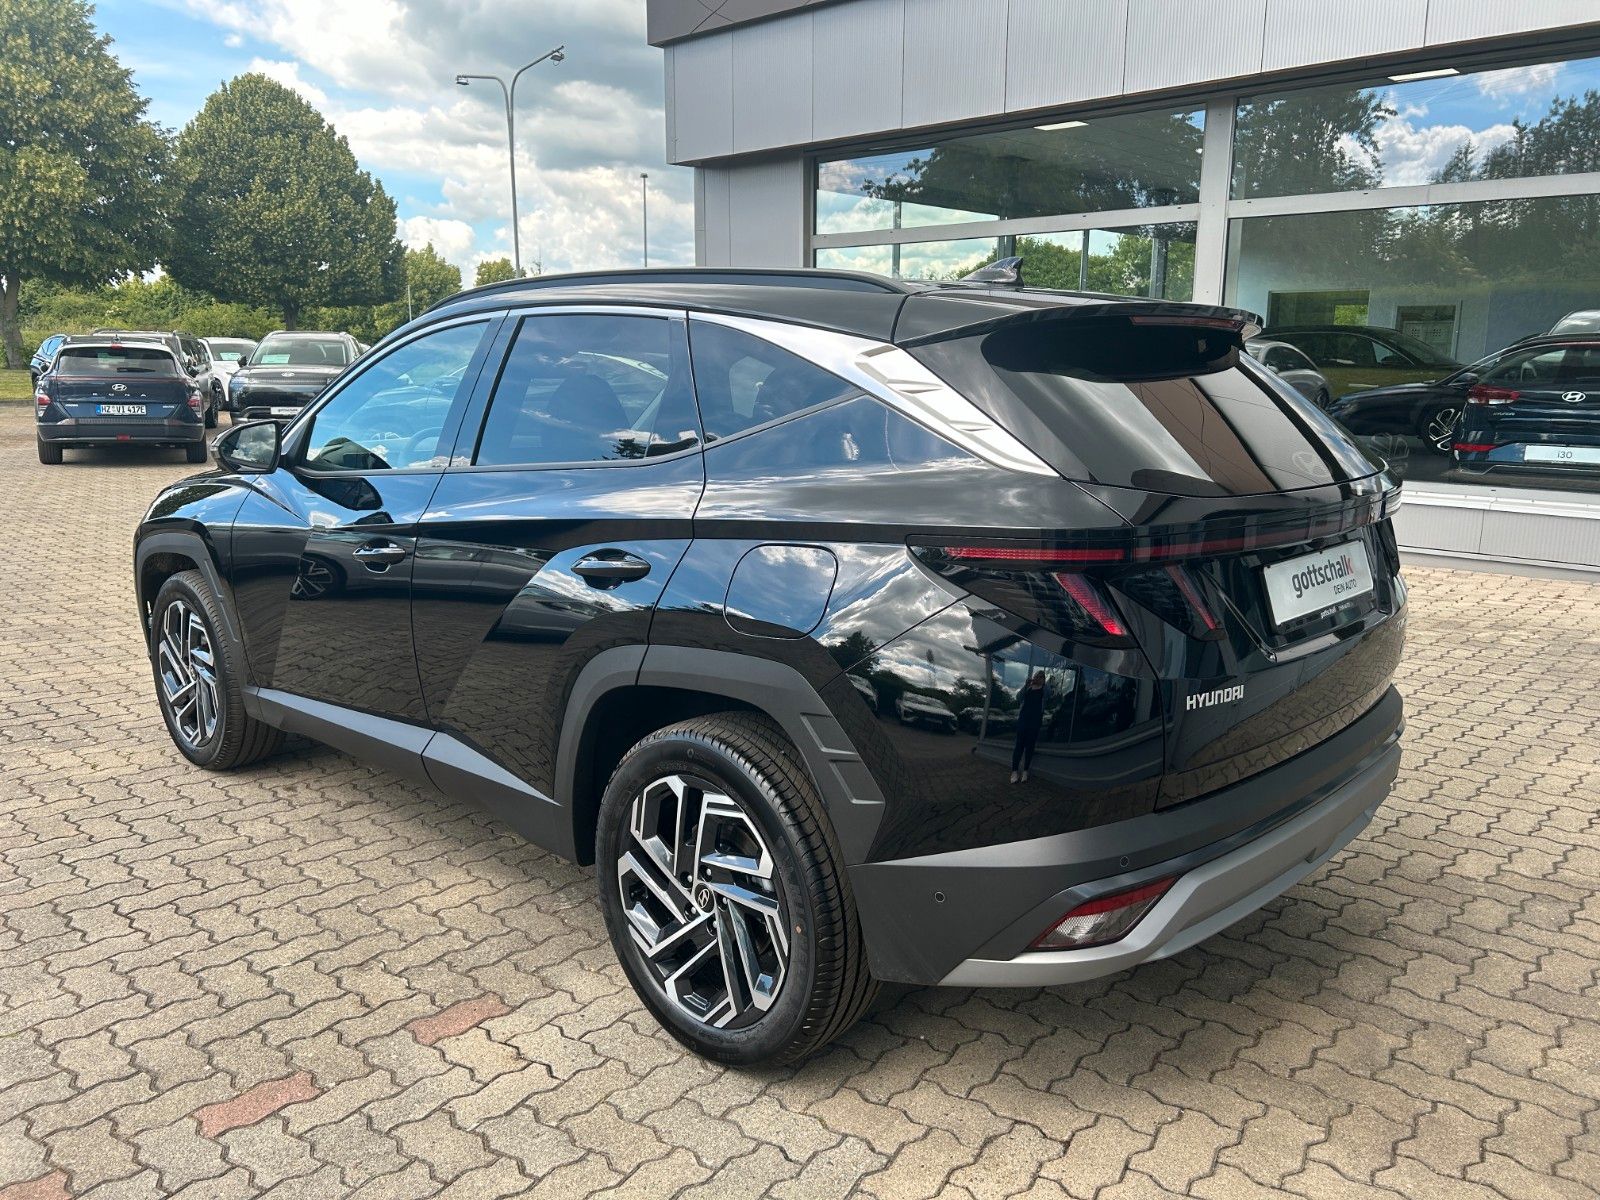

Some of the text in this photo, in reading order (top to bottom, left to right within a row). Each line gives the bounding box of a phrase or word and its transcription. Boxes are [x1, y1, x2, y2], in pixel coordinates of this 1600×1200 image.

[101, 405, 111, 413] HZ
[1557, 450, 1573, 459] i30
[1291, 554, 1354, 599] gottschalk
[1333, 578, 1357, 595] DEIN AUTO
[1186, 684, 1245, 711] HYUNDAI
